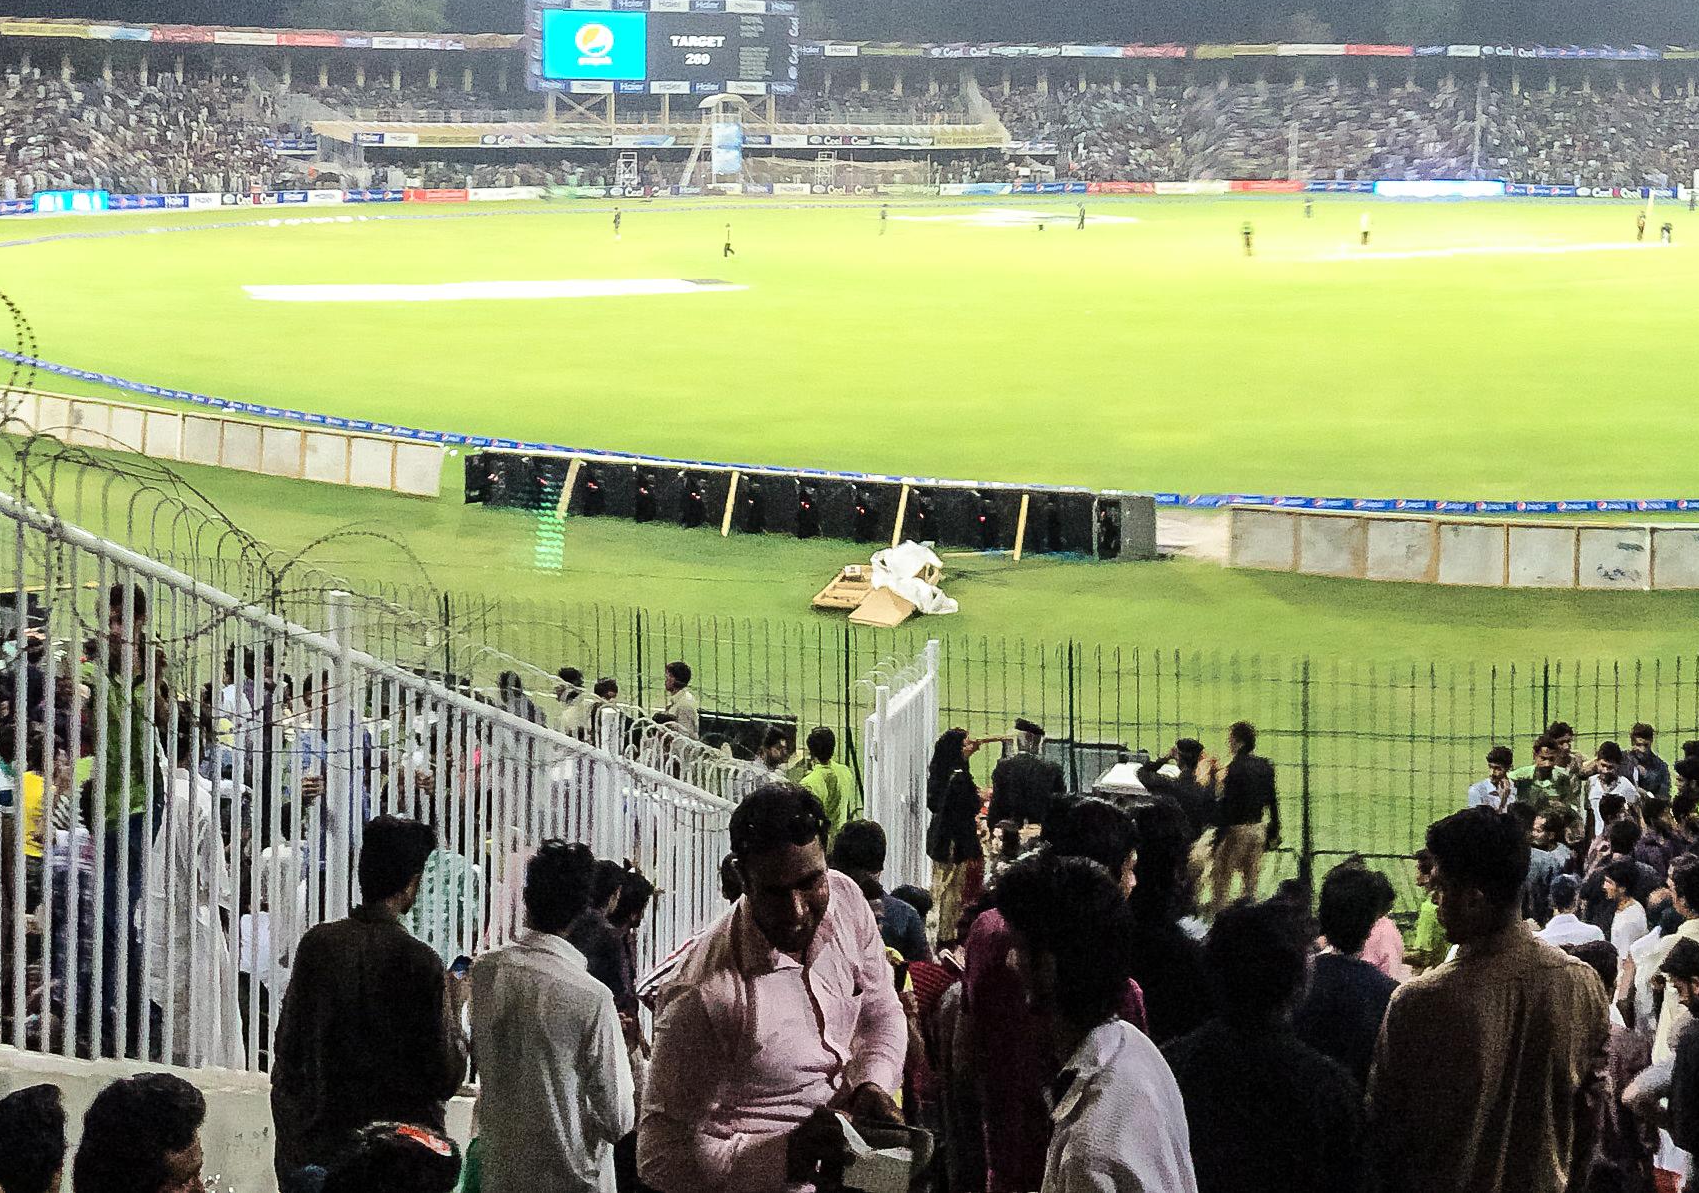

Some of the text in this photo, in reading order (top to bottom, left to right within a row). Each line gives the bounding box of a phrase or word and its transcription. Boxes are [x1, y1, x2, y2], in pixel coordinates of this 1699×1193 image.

[669, 35, 726, 48] TARGET
[684, 53, 711, 66] 269
[165, 195, 186, 207] Haier
